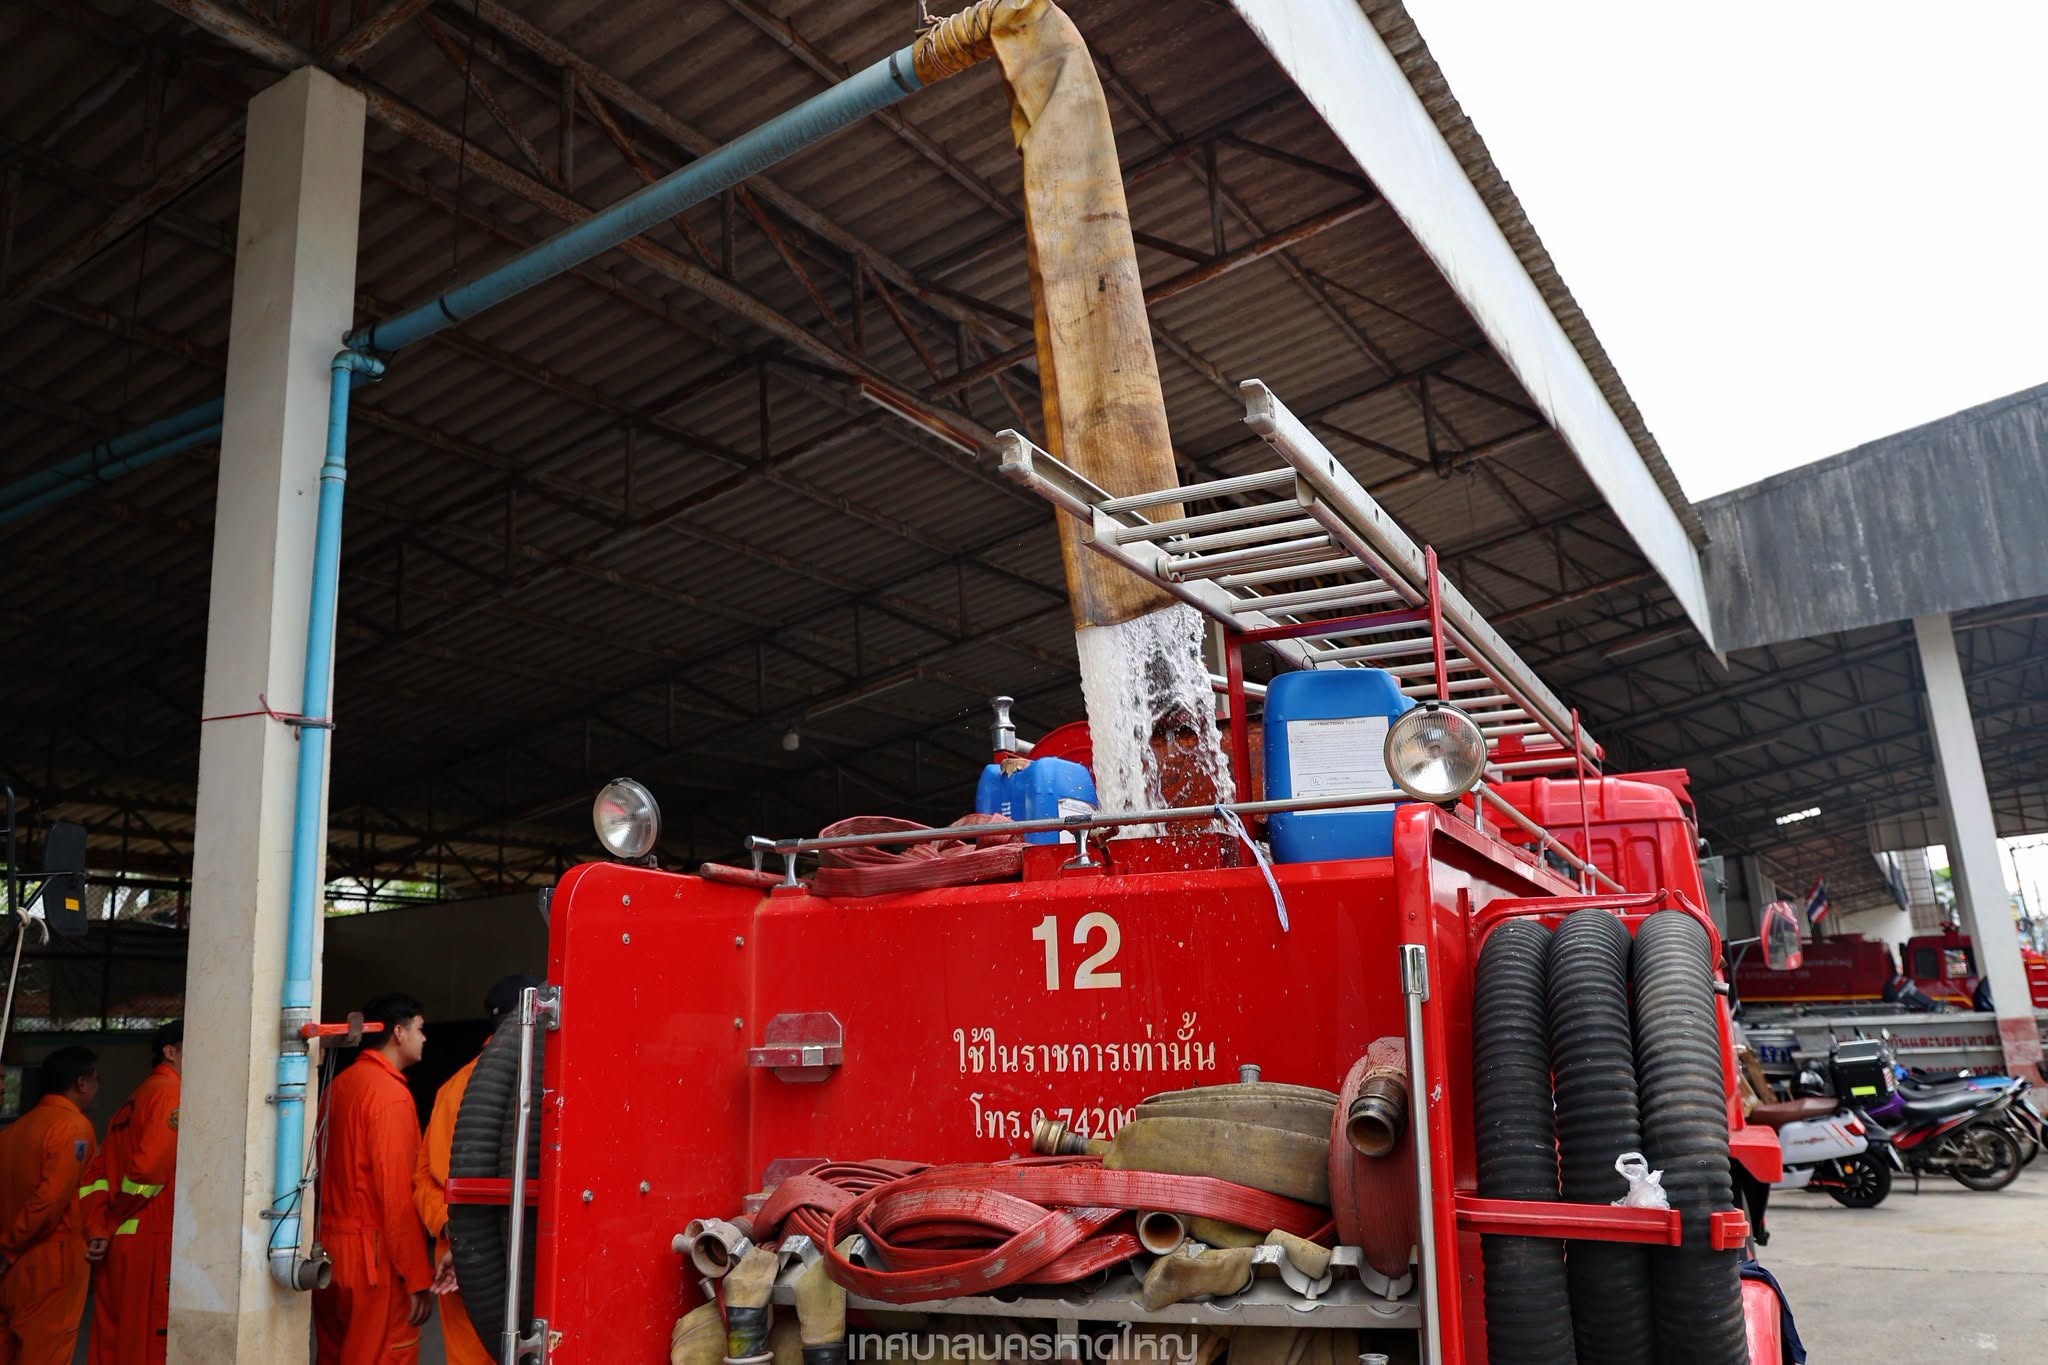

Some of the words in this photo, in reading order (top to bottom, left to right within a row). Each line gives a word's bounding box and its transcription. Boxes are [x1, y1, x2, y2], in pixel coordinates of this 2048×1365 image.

[1032, 912, 1121, 990] 12
[953, 1012, 1216, 1073] ใช้ในราชการเท่านั้น
